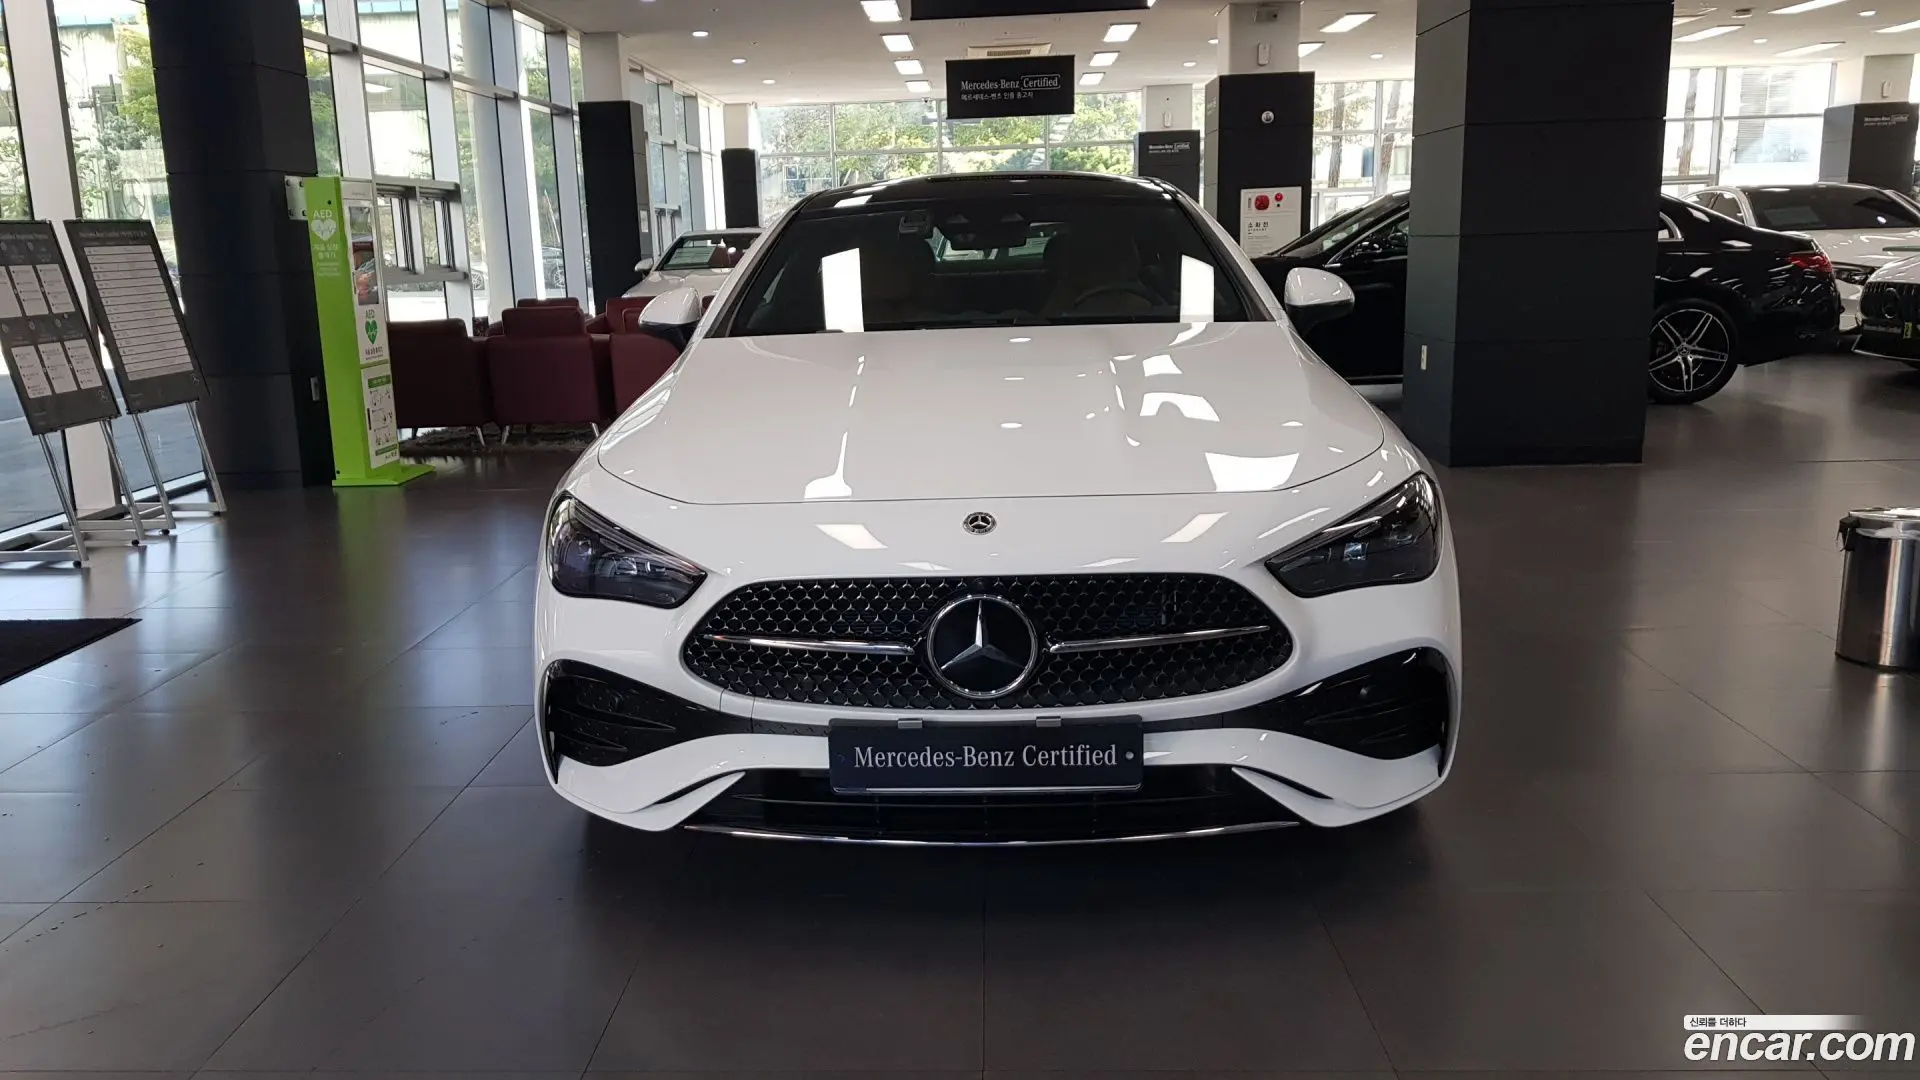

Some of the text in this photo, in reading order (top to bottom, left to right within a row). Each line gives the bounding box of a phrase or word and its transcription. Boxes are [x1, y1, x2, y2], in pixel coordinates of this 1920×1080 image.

[961, 77, 1058, 91] Mercedes-Benz Certified
[313, 209, 332, 218] AED
[854, 744, 1117, 768] Mercedes-Benz Certified
